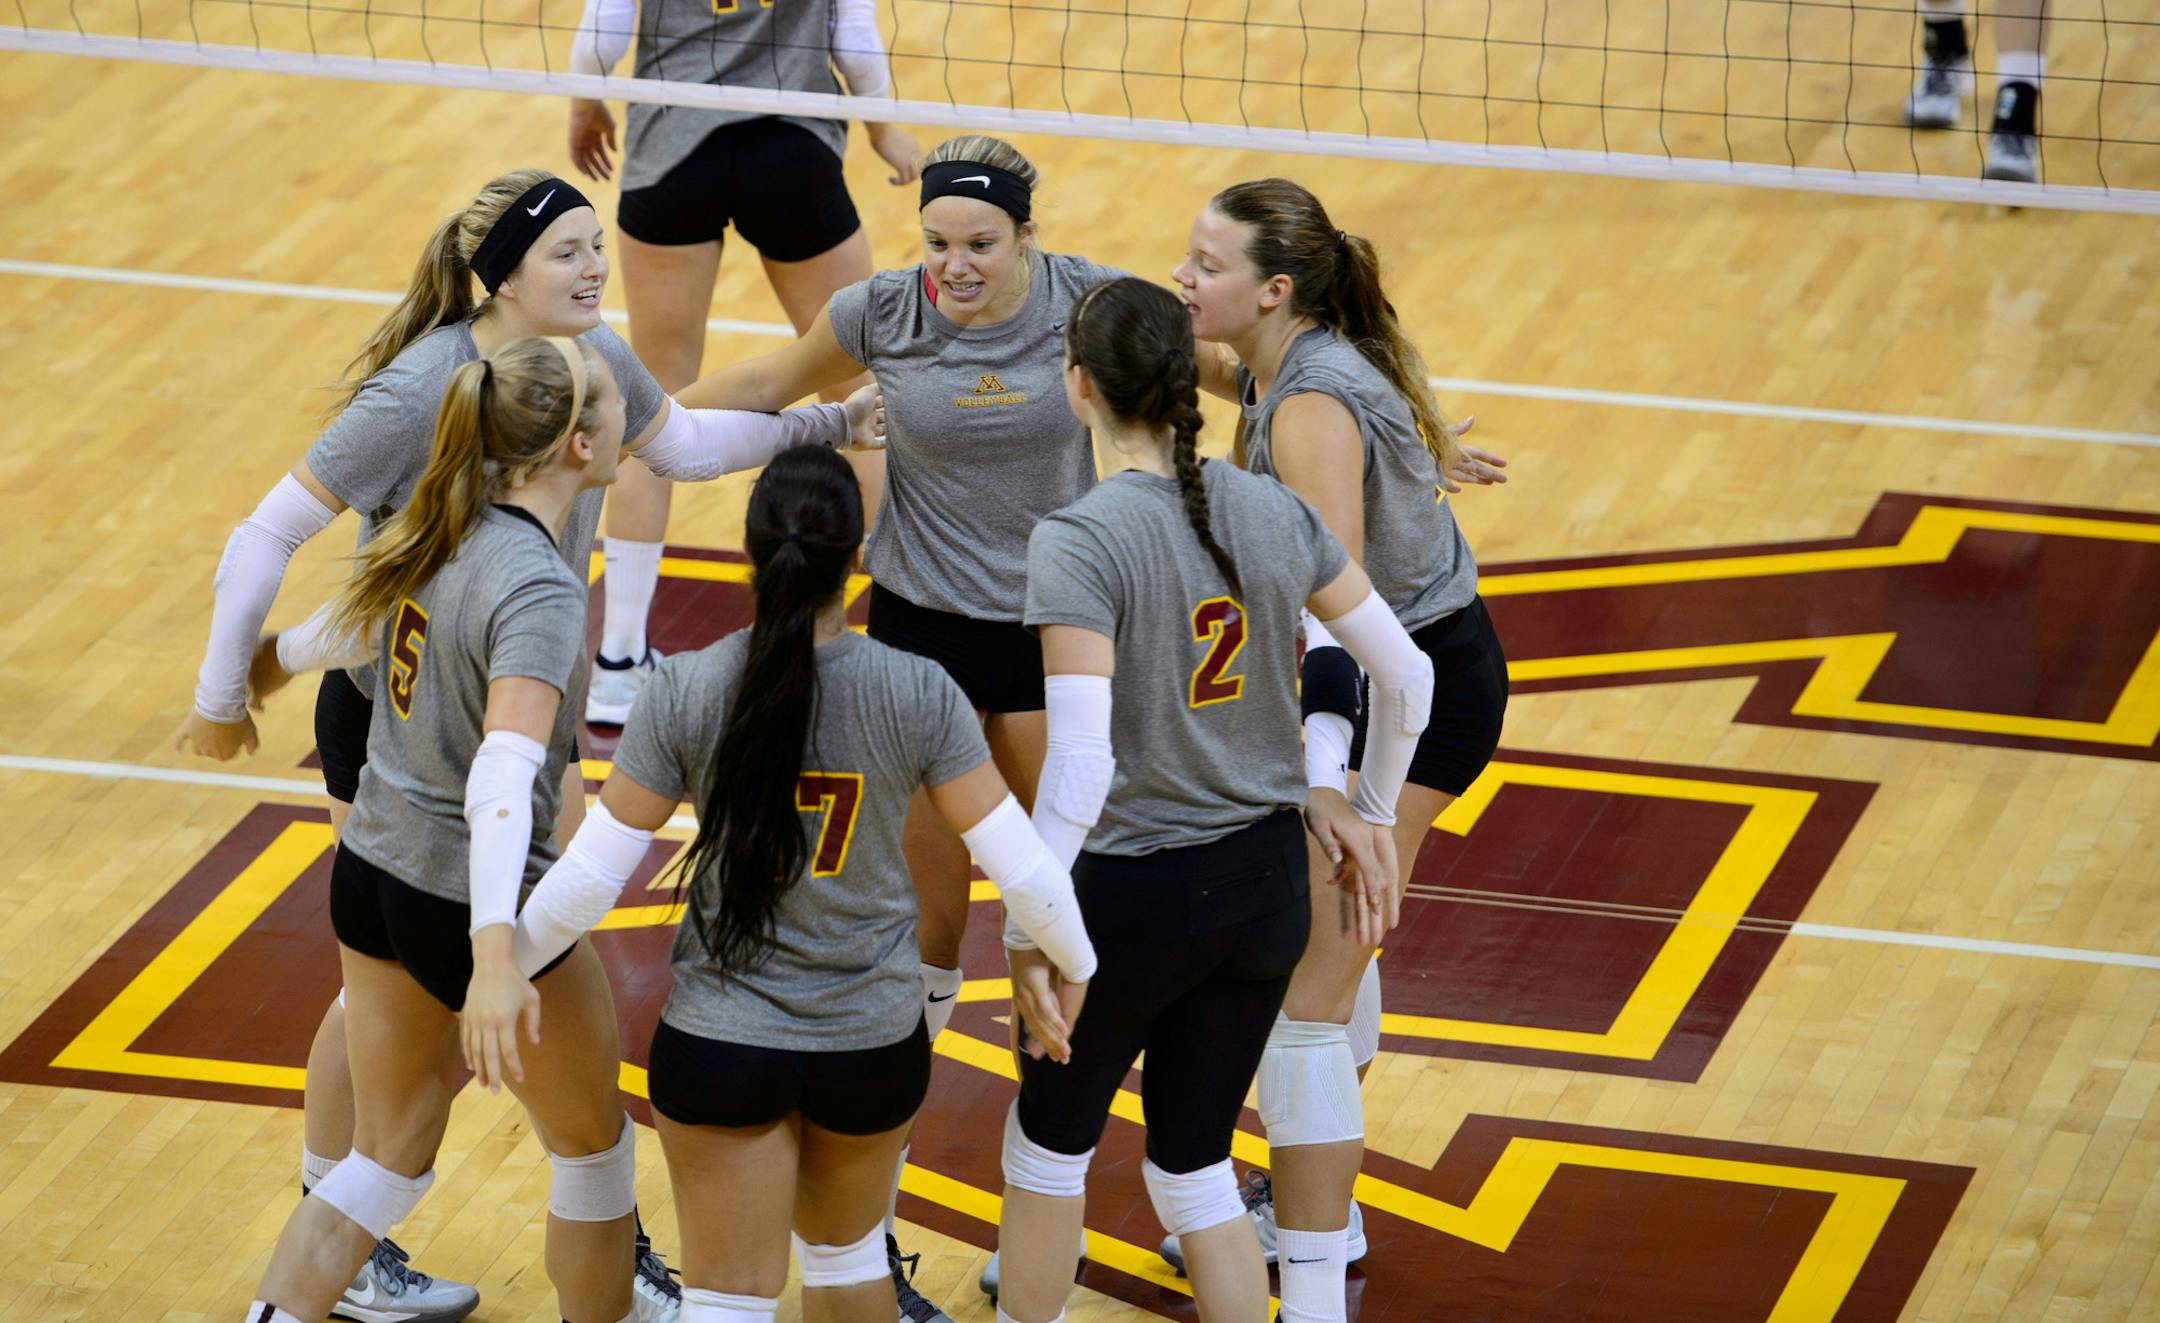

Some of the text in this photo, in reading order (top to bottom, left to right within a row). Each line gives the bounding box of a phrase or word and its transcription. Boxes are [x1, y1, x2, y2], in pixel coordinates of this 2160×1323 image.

[954, 392, 1025, 408] VOLLEYBALL
[390, 598, 429, 720] 5
[1189, 595, 1248, 709] 2
